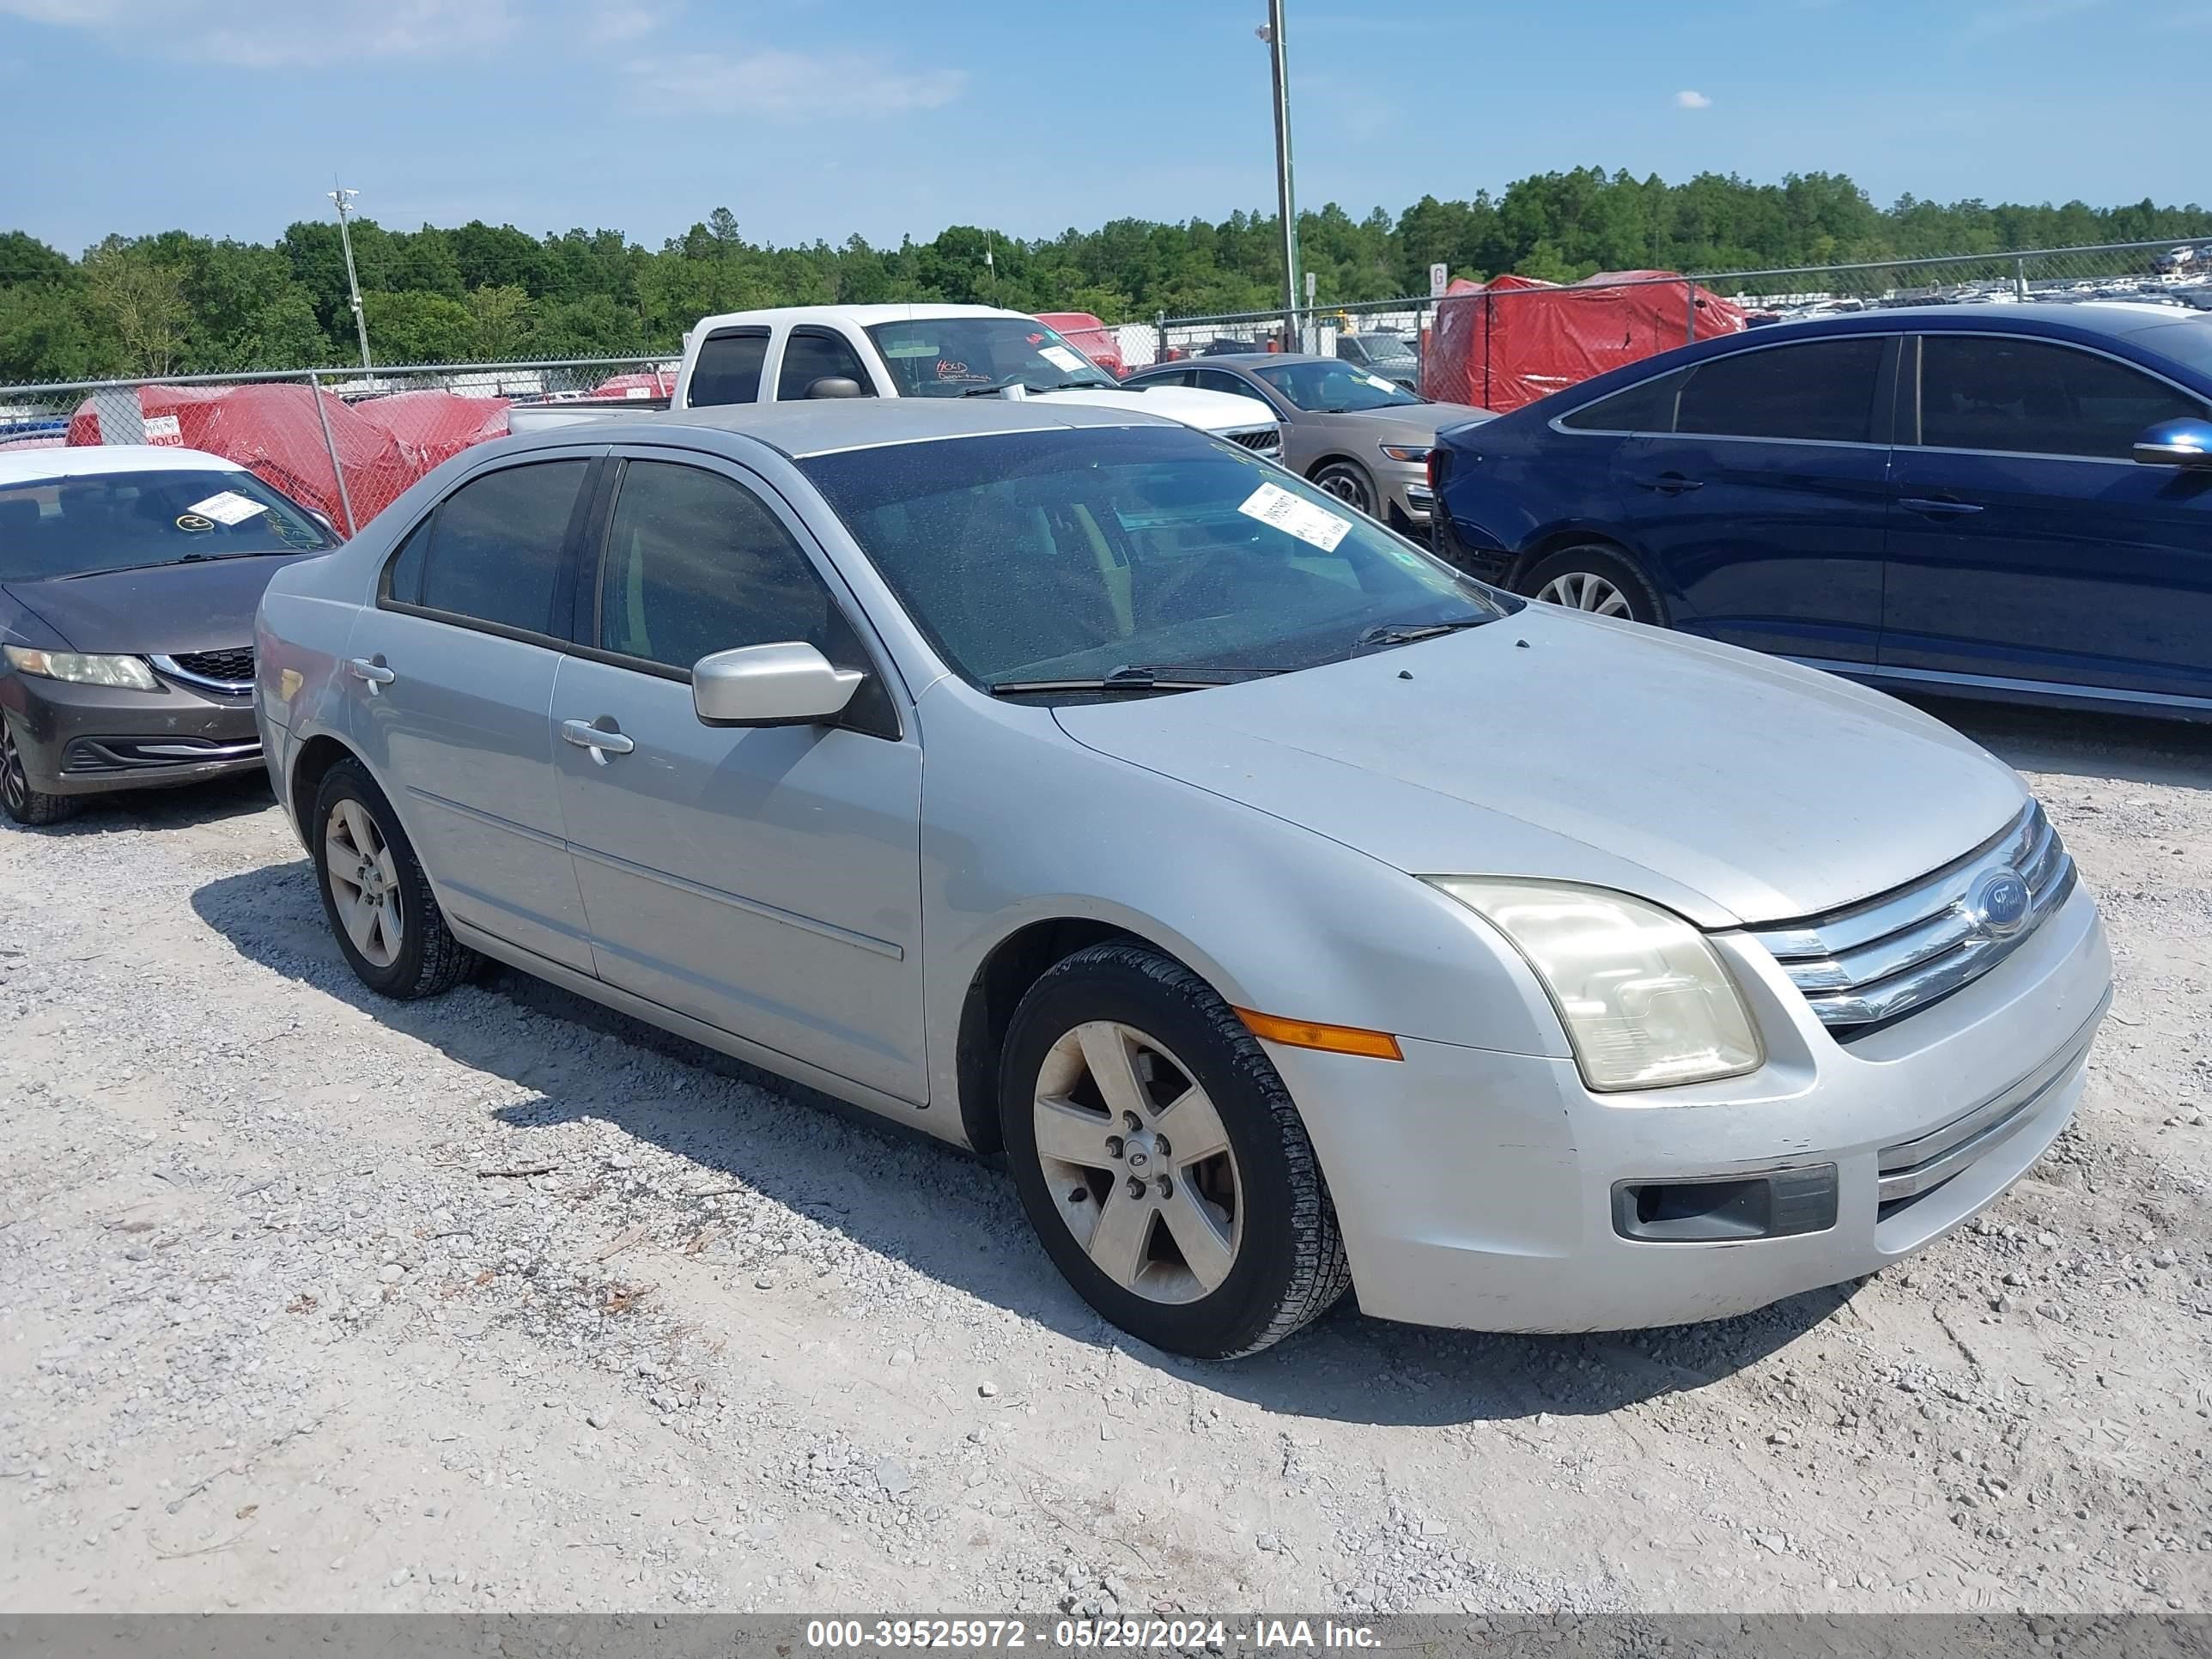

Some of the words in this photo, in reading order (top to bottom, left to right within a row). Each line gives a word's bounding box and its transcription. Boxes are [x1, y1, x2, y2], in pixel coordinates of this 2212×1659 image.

[1435, 268, 1443, 285] G
[937, 359, 969, 373] HOLD
[148, 434, 181, 447] HOLD
